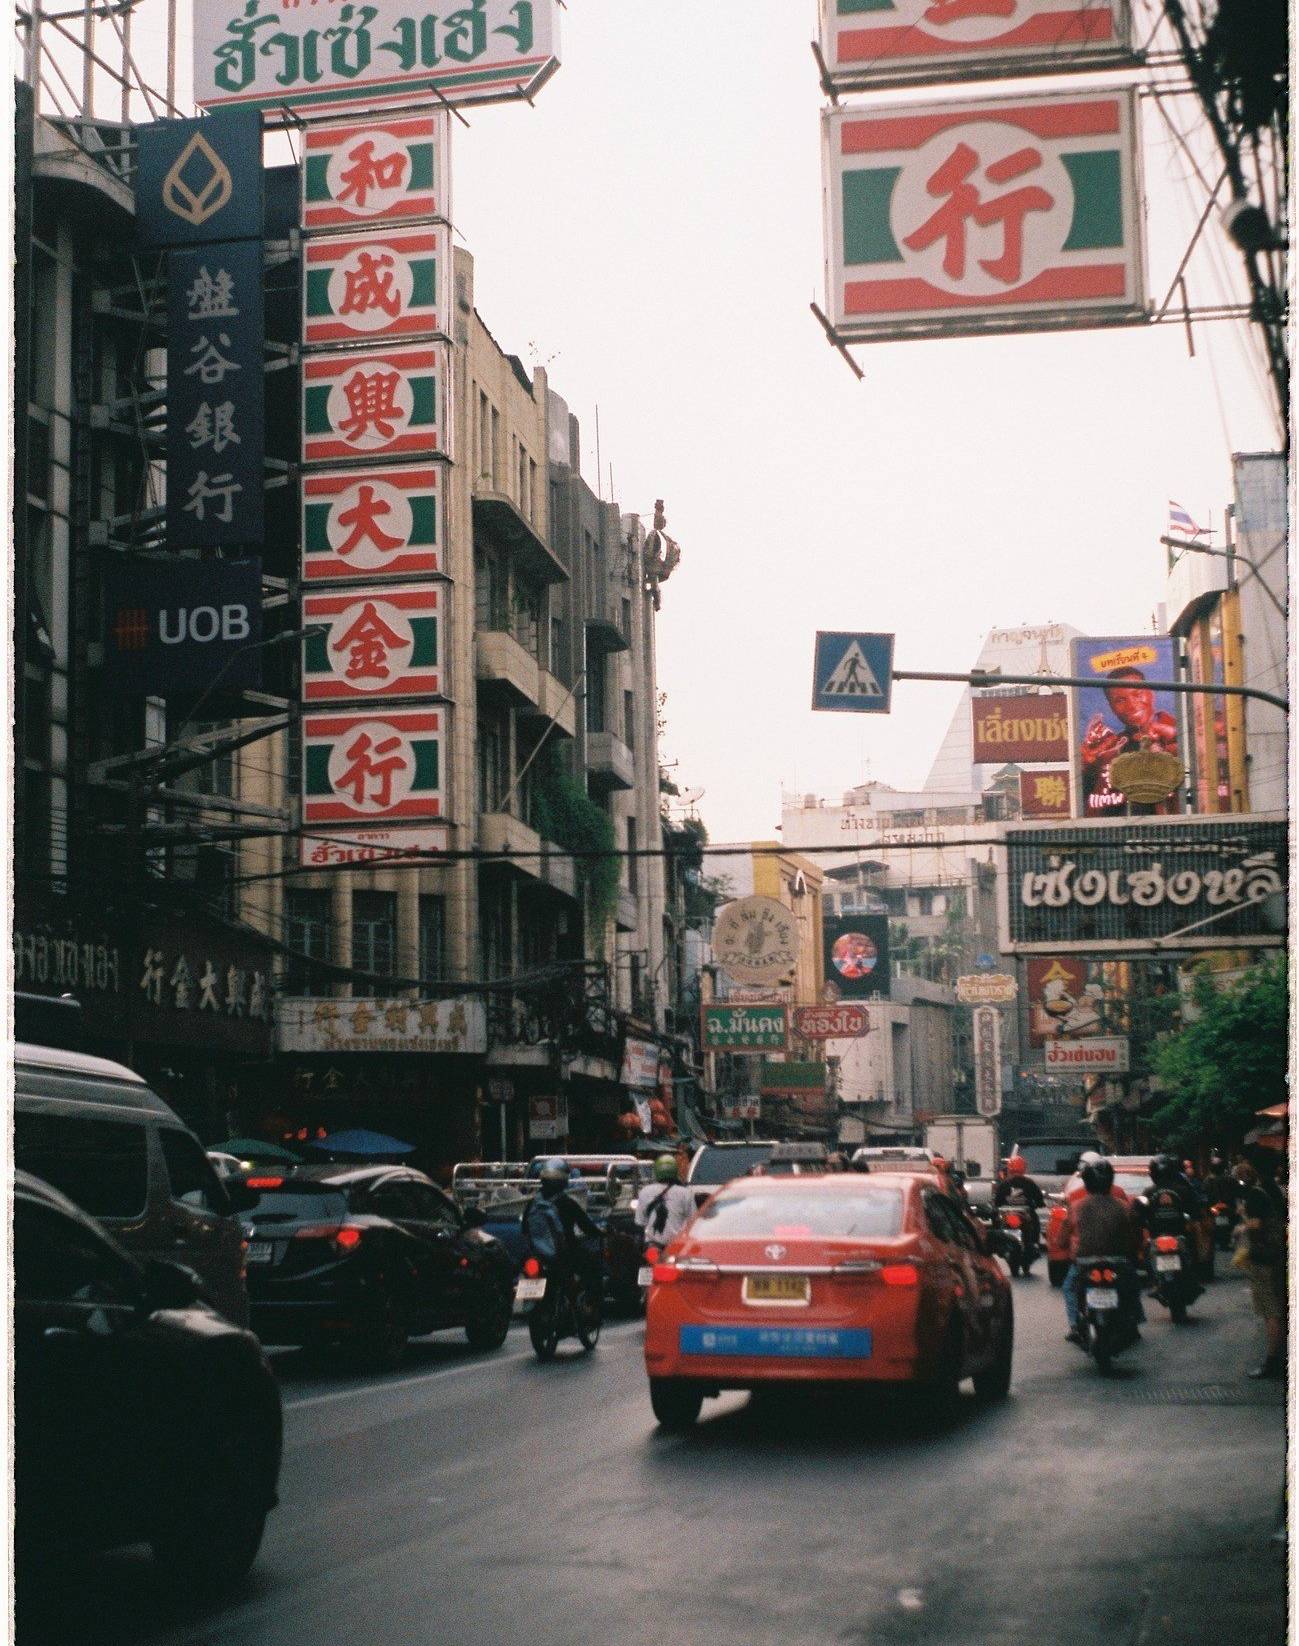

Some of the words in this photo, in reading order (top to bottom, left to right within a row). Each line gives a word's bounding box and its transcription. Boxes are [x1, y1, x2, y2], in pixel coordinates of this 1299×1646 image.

[184, 265, 242, 523] 盤谷銀行
[157, 603, 251, 645] UOB
